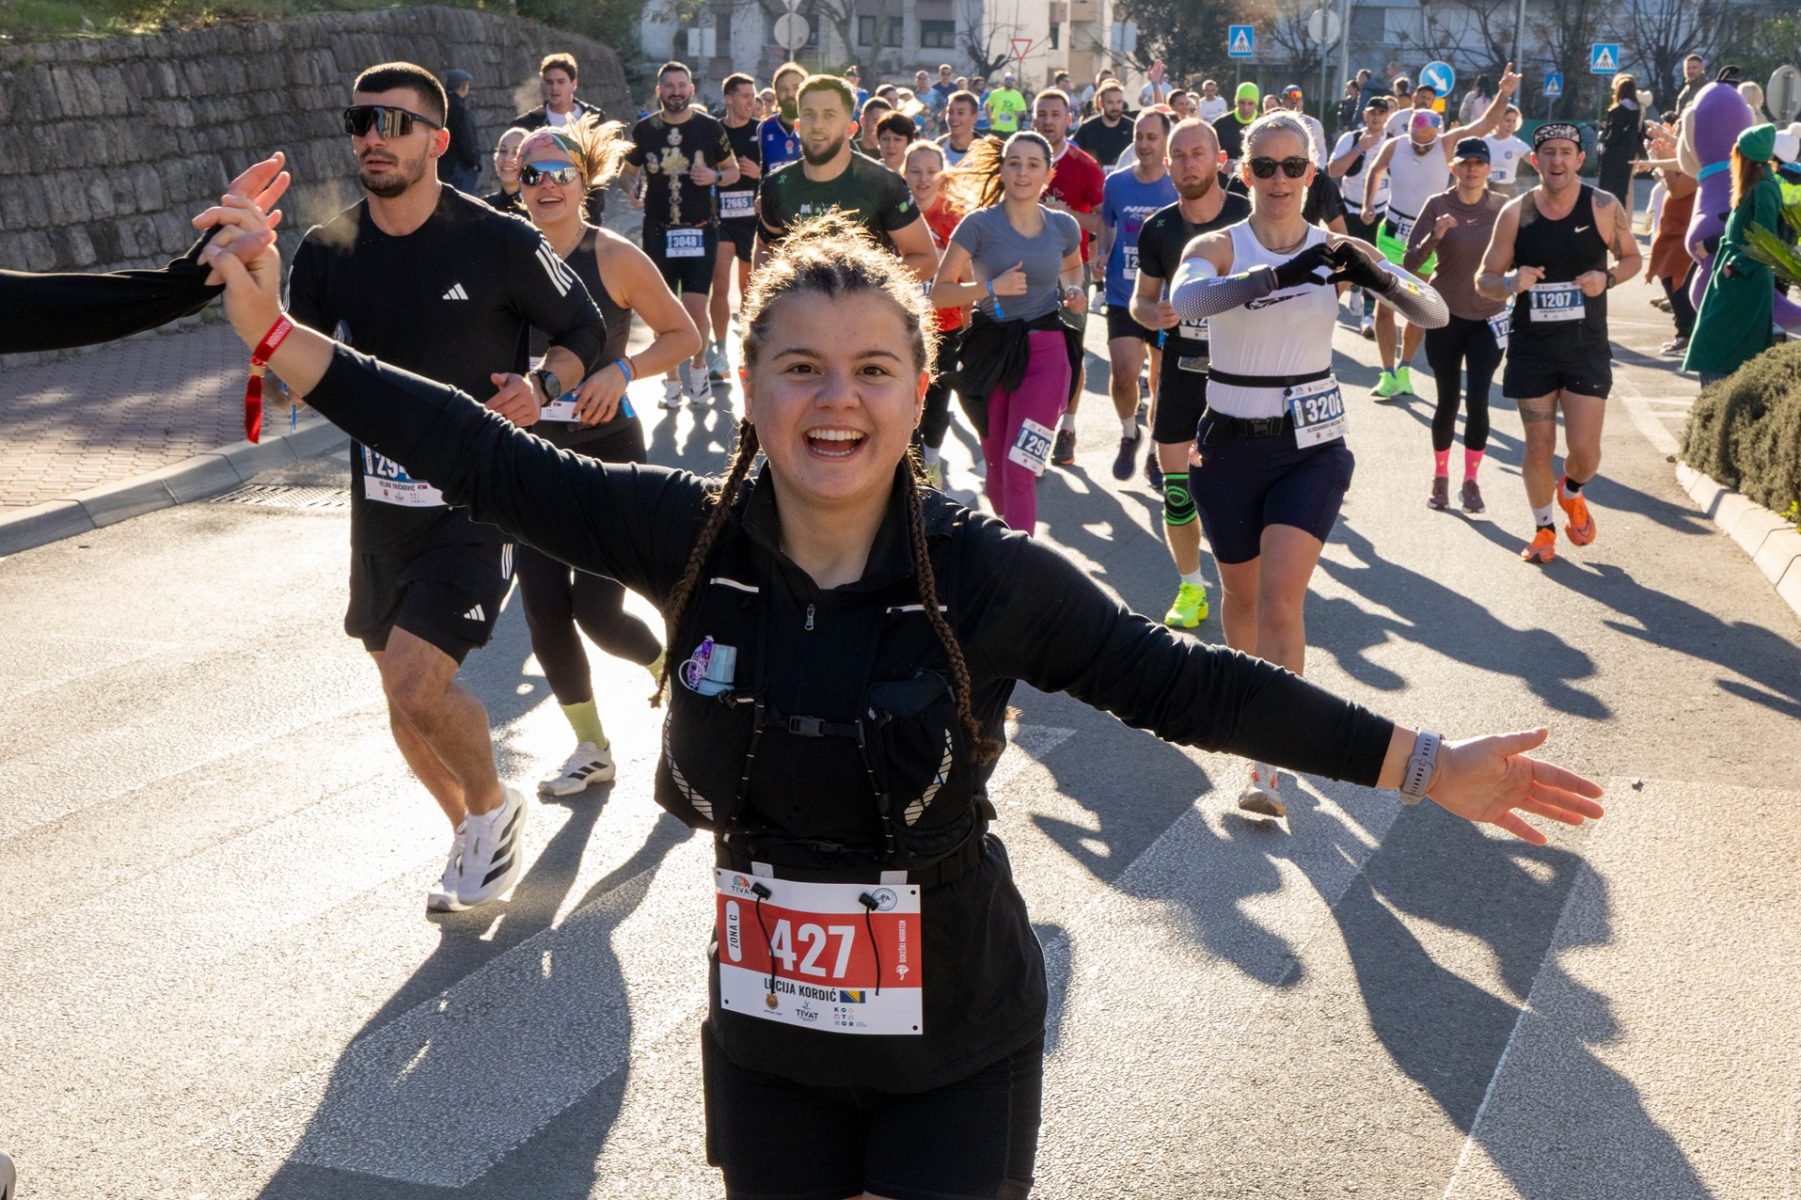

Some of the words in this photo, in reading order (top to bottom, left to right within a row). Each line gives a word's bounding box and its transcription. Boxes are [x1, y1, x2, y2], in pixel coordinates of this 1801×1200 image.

[673, 235, 697, 248] 3048
[1540, 292, 1572, 308] 1207
[731, 885, 752, 895] TIVA
[729, 925, 739, 949] ZONA
[768, 918, 856, 979] 427
[799, 985, 837, 1002] KORDIĆ
[795, 1009, 819, 1019] TIVAT
